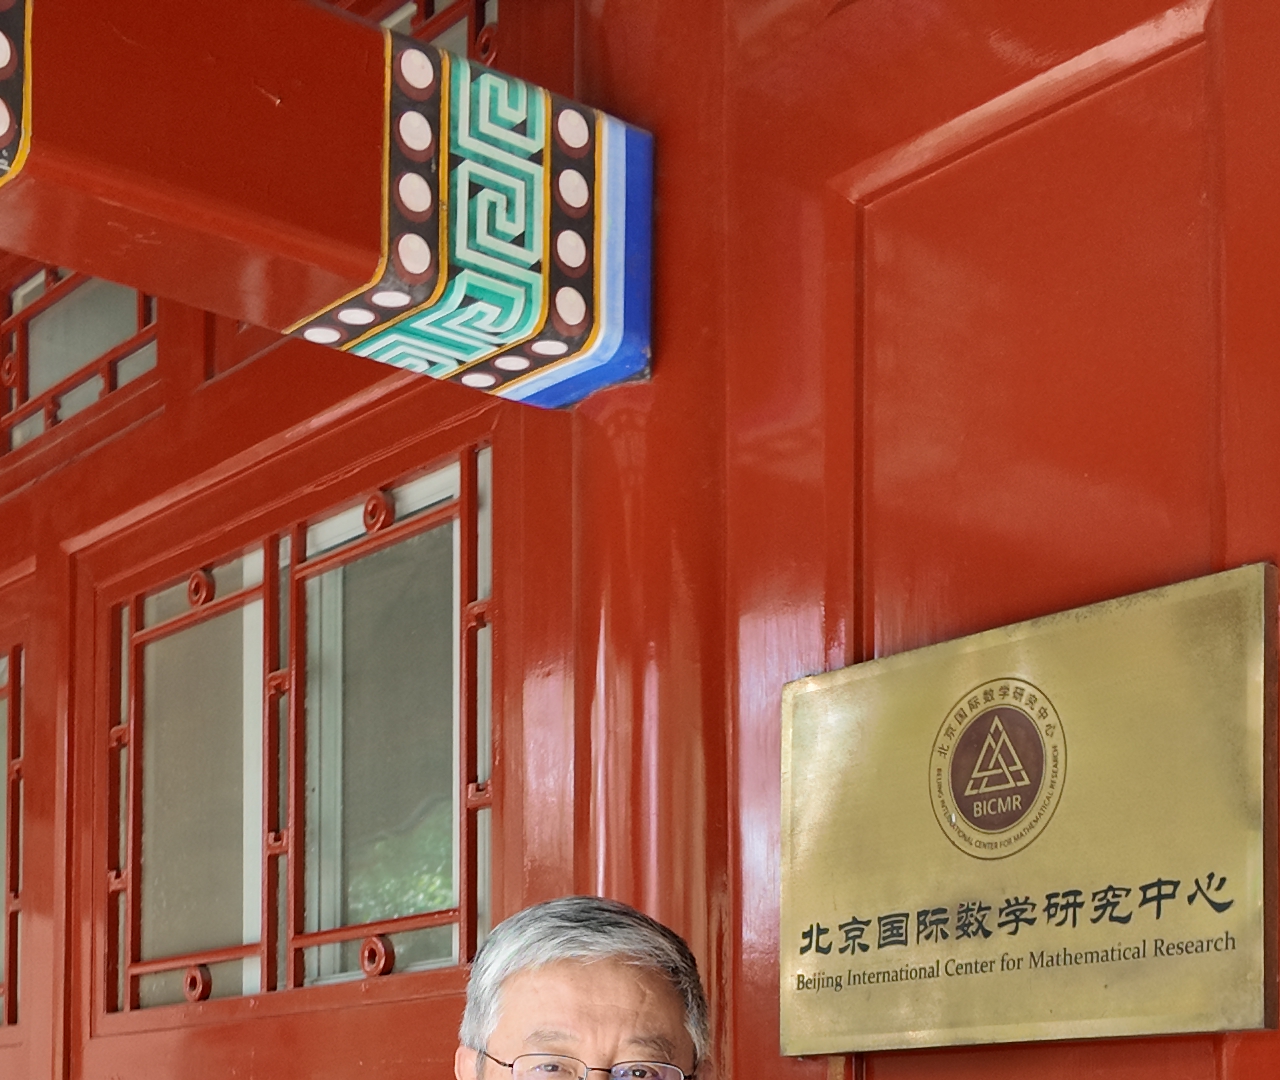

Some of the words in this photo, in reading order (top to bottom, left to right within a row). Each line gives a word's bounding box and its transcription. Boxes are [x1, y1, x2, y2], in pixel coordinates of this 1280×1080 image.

[937, 684, 1057, 760] 北京国际数学研究中心
[973, 794, 1023, 818] BICMR
[974, 839, 998, 850] CENTER
[999, 838, 1012, 849] FOR
[1013, 791, 1054, 844] MATHEMATICAL
[1049, 745, 1059, 790] RESEARCH
[799, 871, 1235, 956] 北京国际数学研究中心
[796, 971, 842, 993] Beijing
[847, 960, 940, 986] International
[944, 958, 995, 977] Center
[1001, 952, 1023, 972] for
[1029, 939, 1147, 969] Mathematical
[1154, 930, 1236, 958] Research
